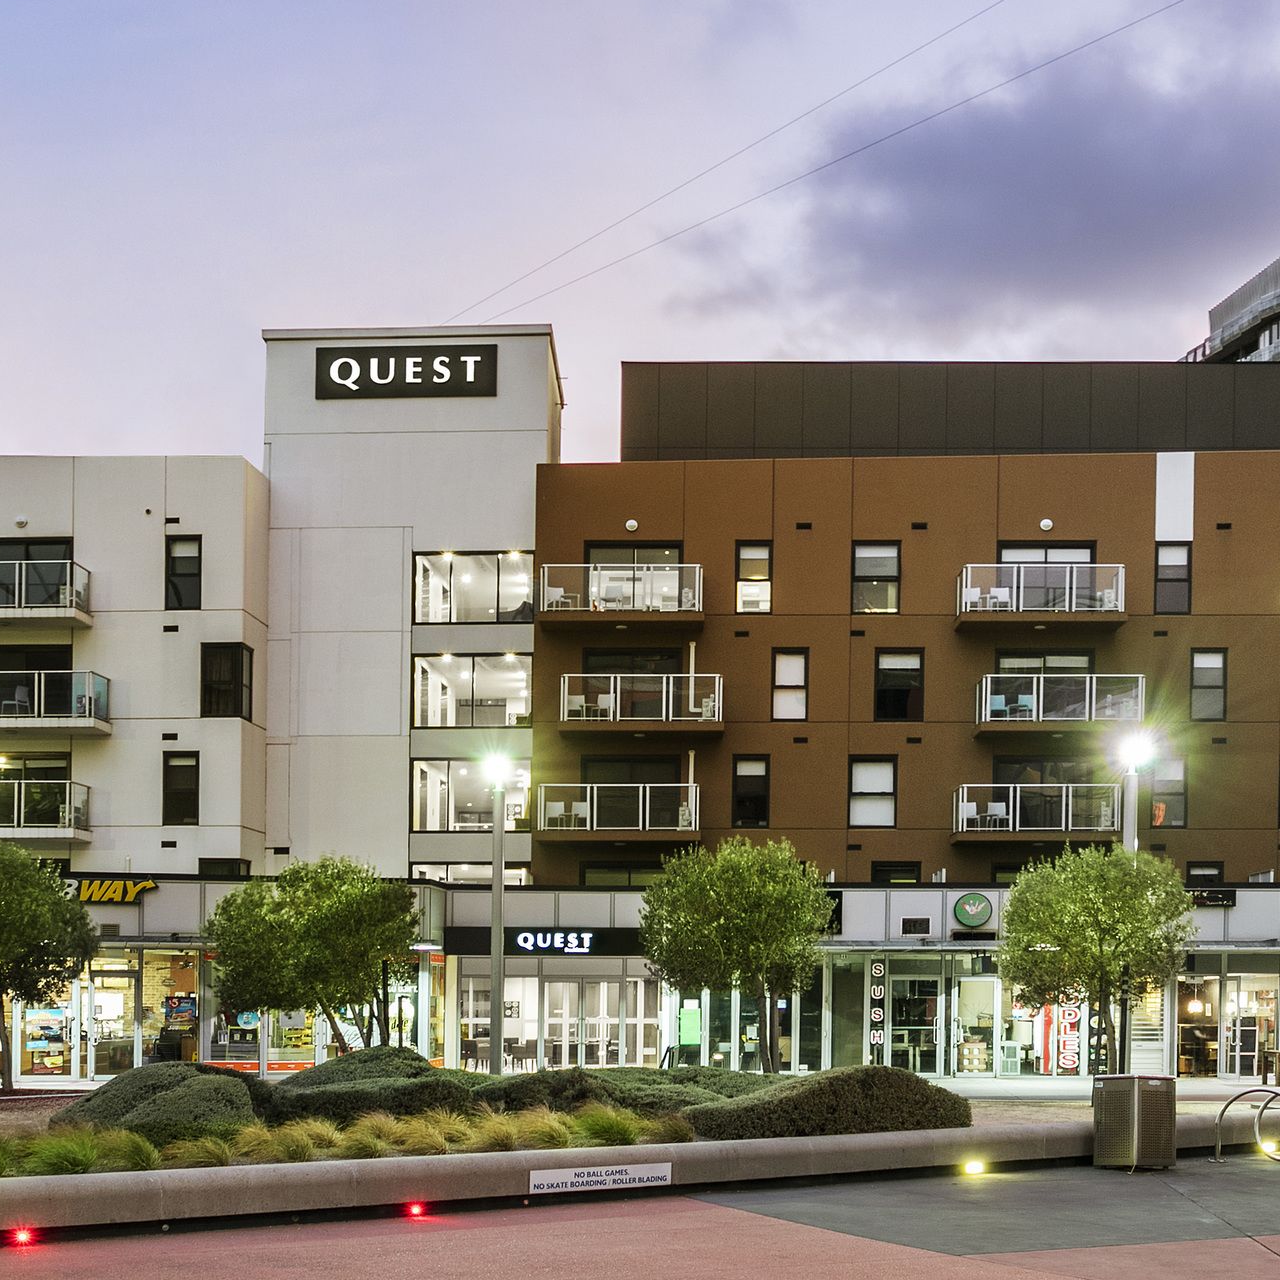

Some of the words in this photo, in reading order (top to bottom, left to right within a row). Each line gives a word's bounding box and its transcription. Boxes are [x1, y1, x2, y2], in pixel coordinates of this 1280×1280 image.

[329, 356, 482, 391] QUEST
[61, 879, 156, 902] BWAY
[517, 932, 593, 950] QUEST
[1058, 992, 1081, 1069] ODLES
[546, 1181, 568, 1189] SKATE
[570, 1179, 607, 1188] BOARDING
[612, 1177, 637, 1185] ROLLER
[638, 1175, 667, 1183] BLADING
[605, 1169, 630, 1177] GAMES.
